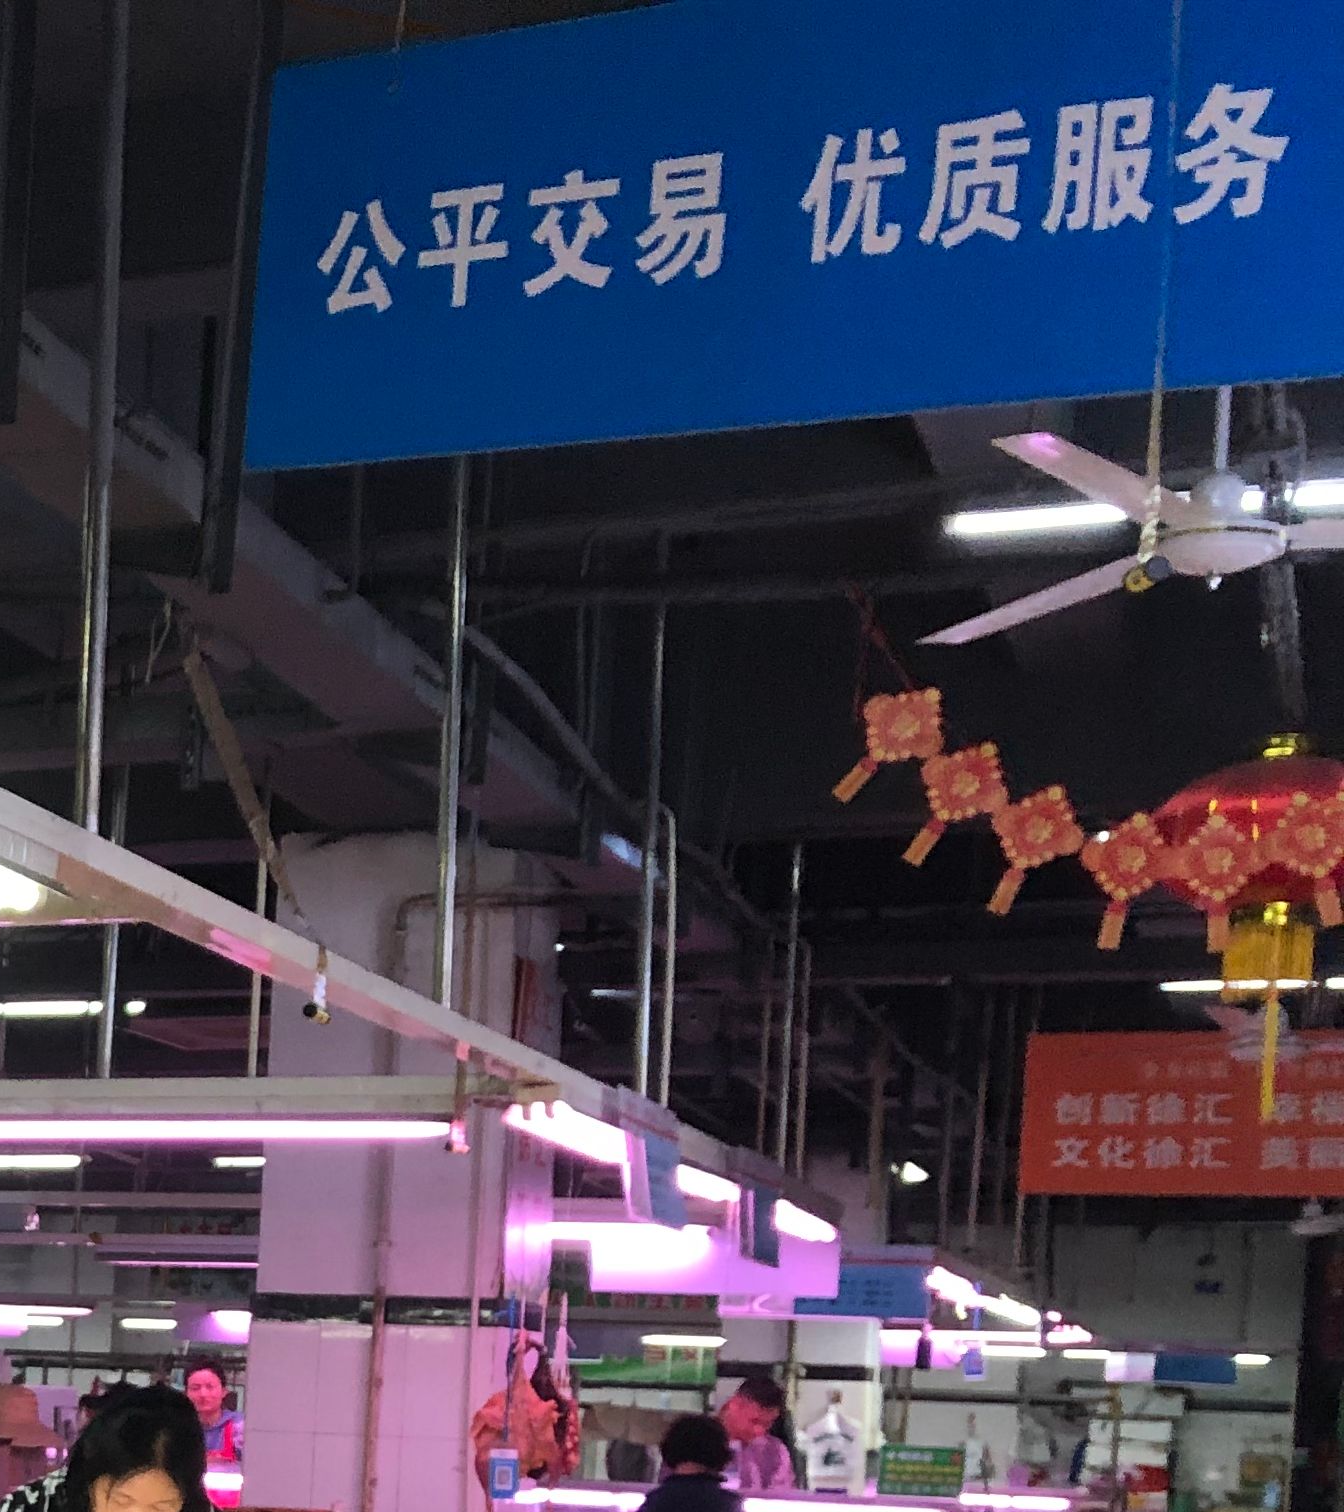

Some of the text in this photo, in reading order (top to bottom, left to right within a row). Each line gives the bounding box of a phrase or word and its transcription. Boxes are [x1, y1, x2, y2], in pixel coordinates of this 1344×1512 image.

[316, 82, 1289, 314] 公平交易 优质服务
